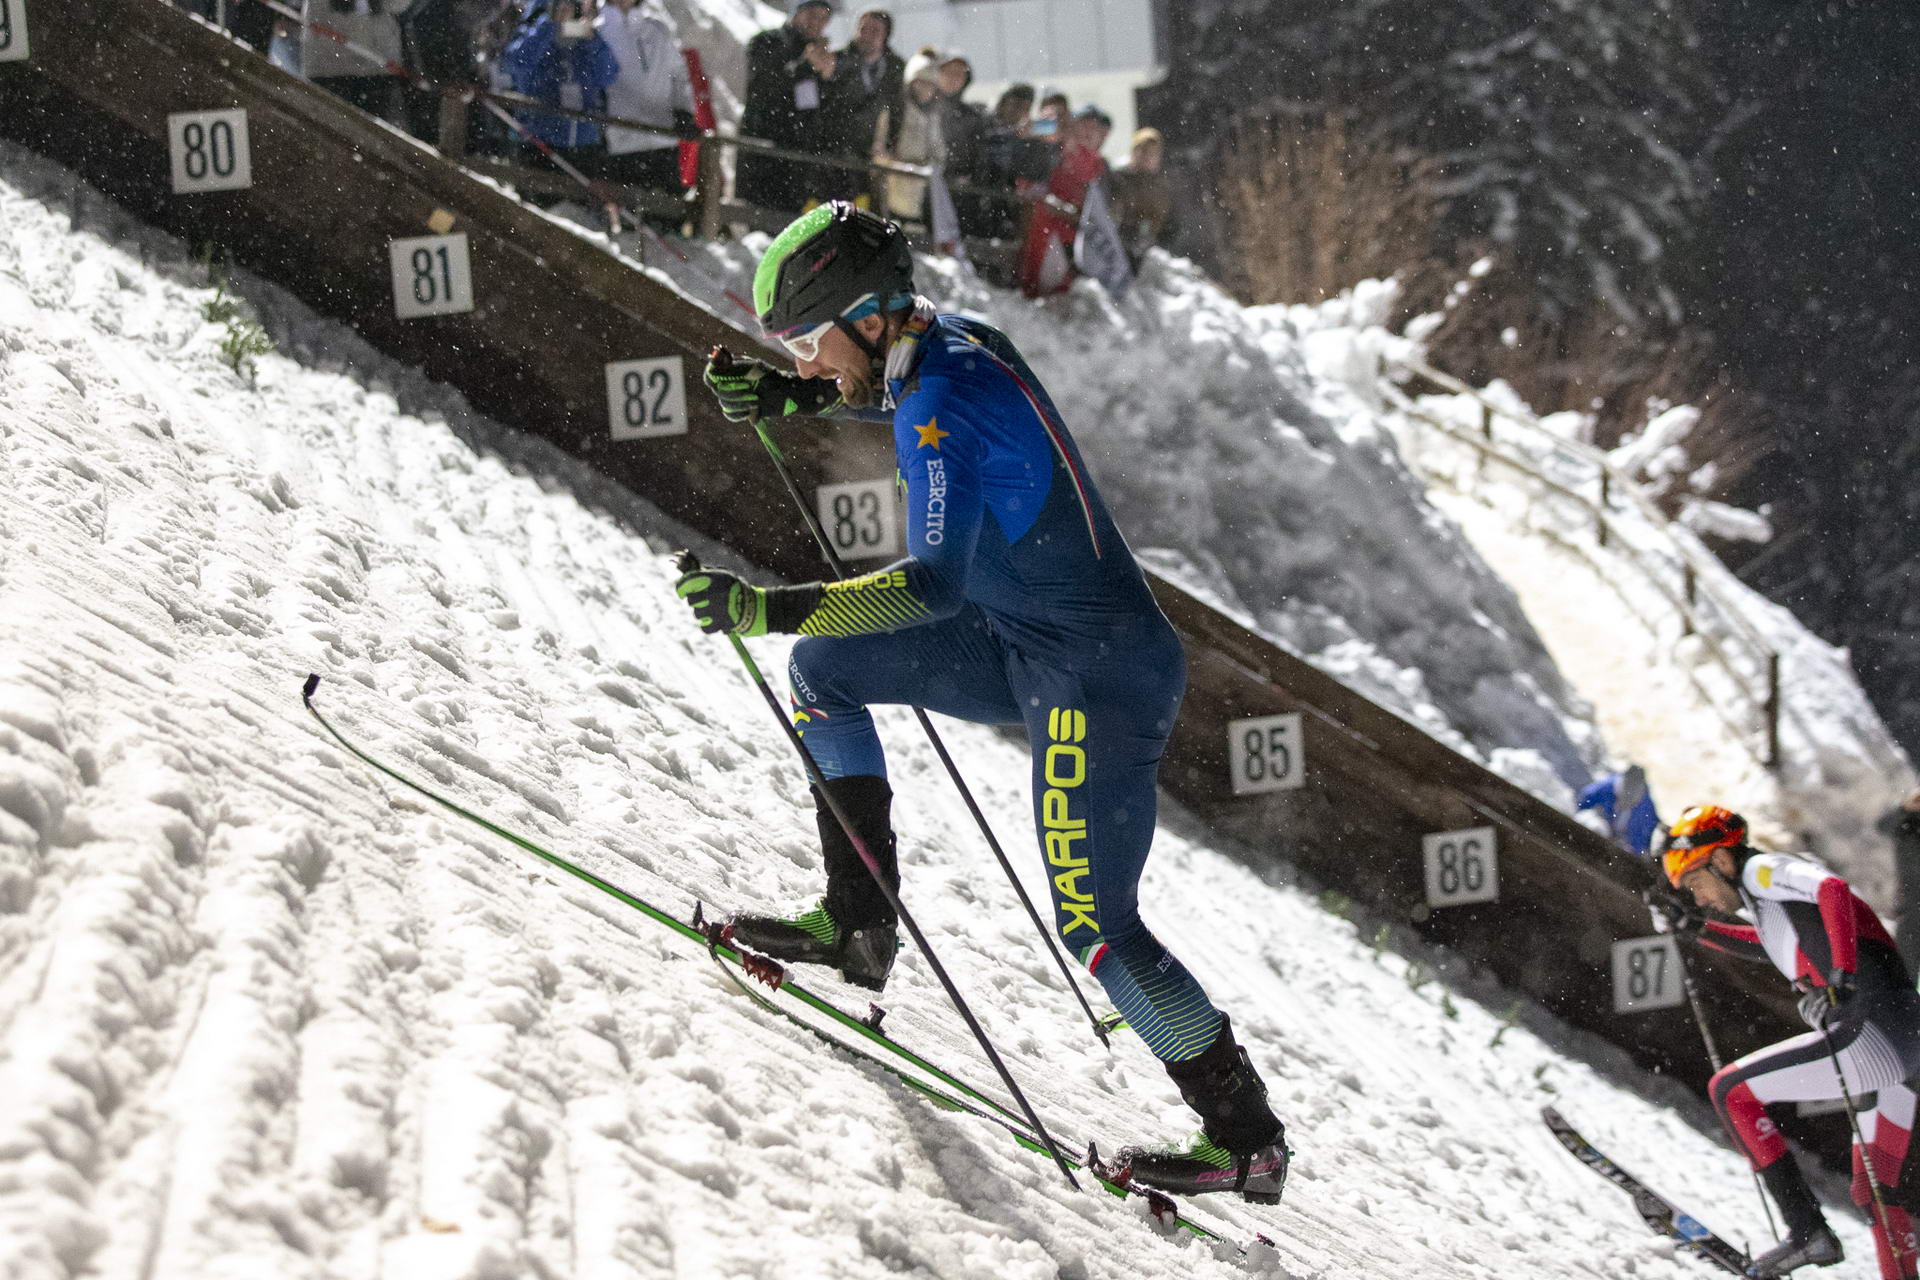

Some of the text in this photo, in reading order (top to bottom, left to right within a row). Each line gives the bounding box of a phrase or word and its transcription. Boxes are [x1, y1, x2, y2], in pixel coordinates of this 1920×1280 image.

[184, 121, 235, 178] 80
[413, 246, 451, 304] 81
[623, 370, 672, 427] 82
[833, 491, 882, 548] 83
[926, 458, 947, 546] ESERCITO
[1245, 727, 1290, 780] 85
[1043, 707, 1100, 936] KARPOS
[1440, 840, 1484, 894] 86
[1629, 946, 1665, 998] 87
